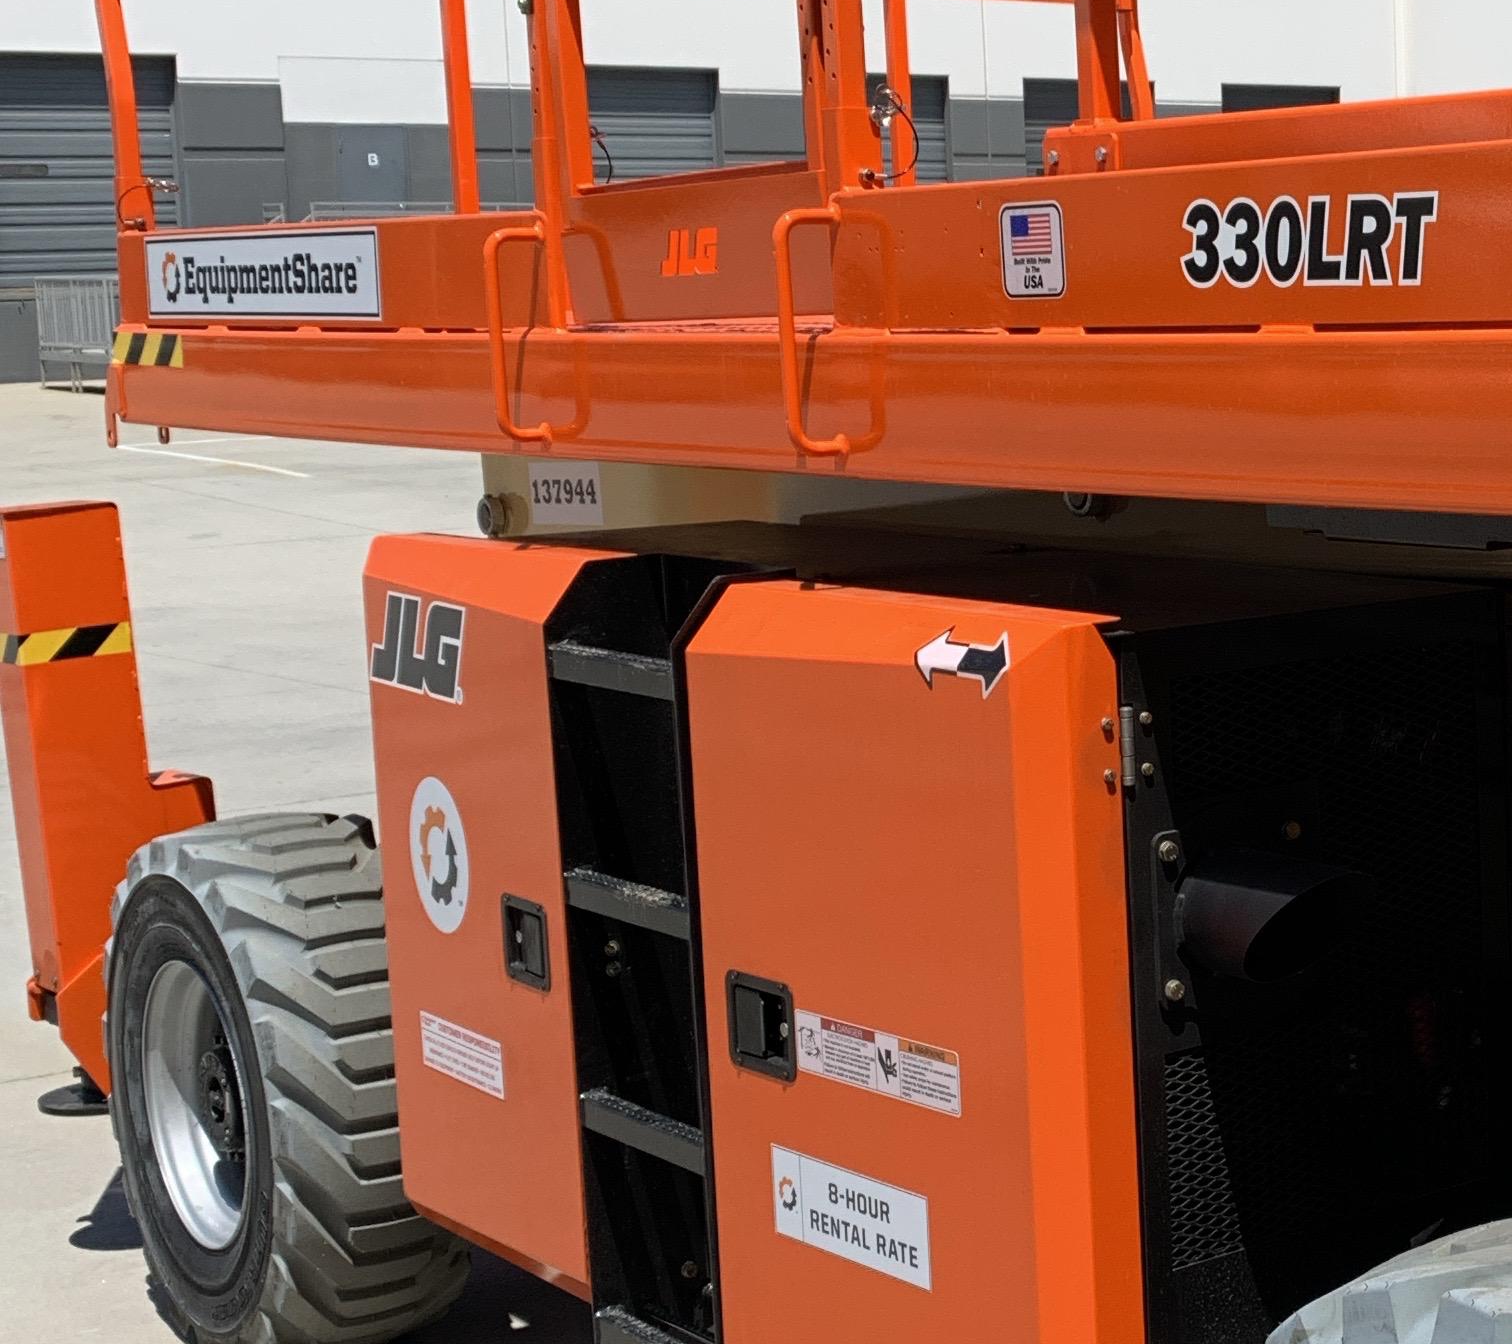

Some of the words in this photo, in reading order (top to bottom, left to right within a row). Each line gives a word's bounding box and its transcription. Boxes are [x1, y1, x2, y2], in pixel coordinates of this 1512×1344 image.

[660, 226, 718, 276] JLG
[1181, 192, 1437, 287] 330LRT
[182, 253, 358, 304] EquipmentShare
[1024, 275, 1044, 289] USA
[532, 479, 597, 504] 137944
[370, 591, 464, 705] JLG
[836, 1024, 863, 1040] DANGER
[828, 1182, 891, 1224] 8-HOUR
[809, 1208, 871, 1251] RENTAL
[876, 1232, 919, 1269] RATE
